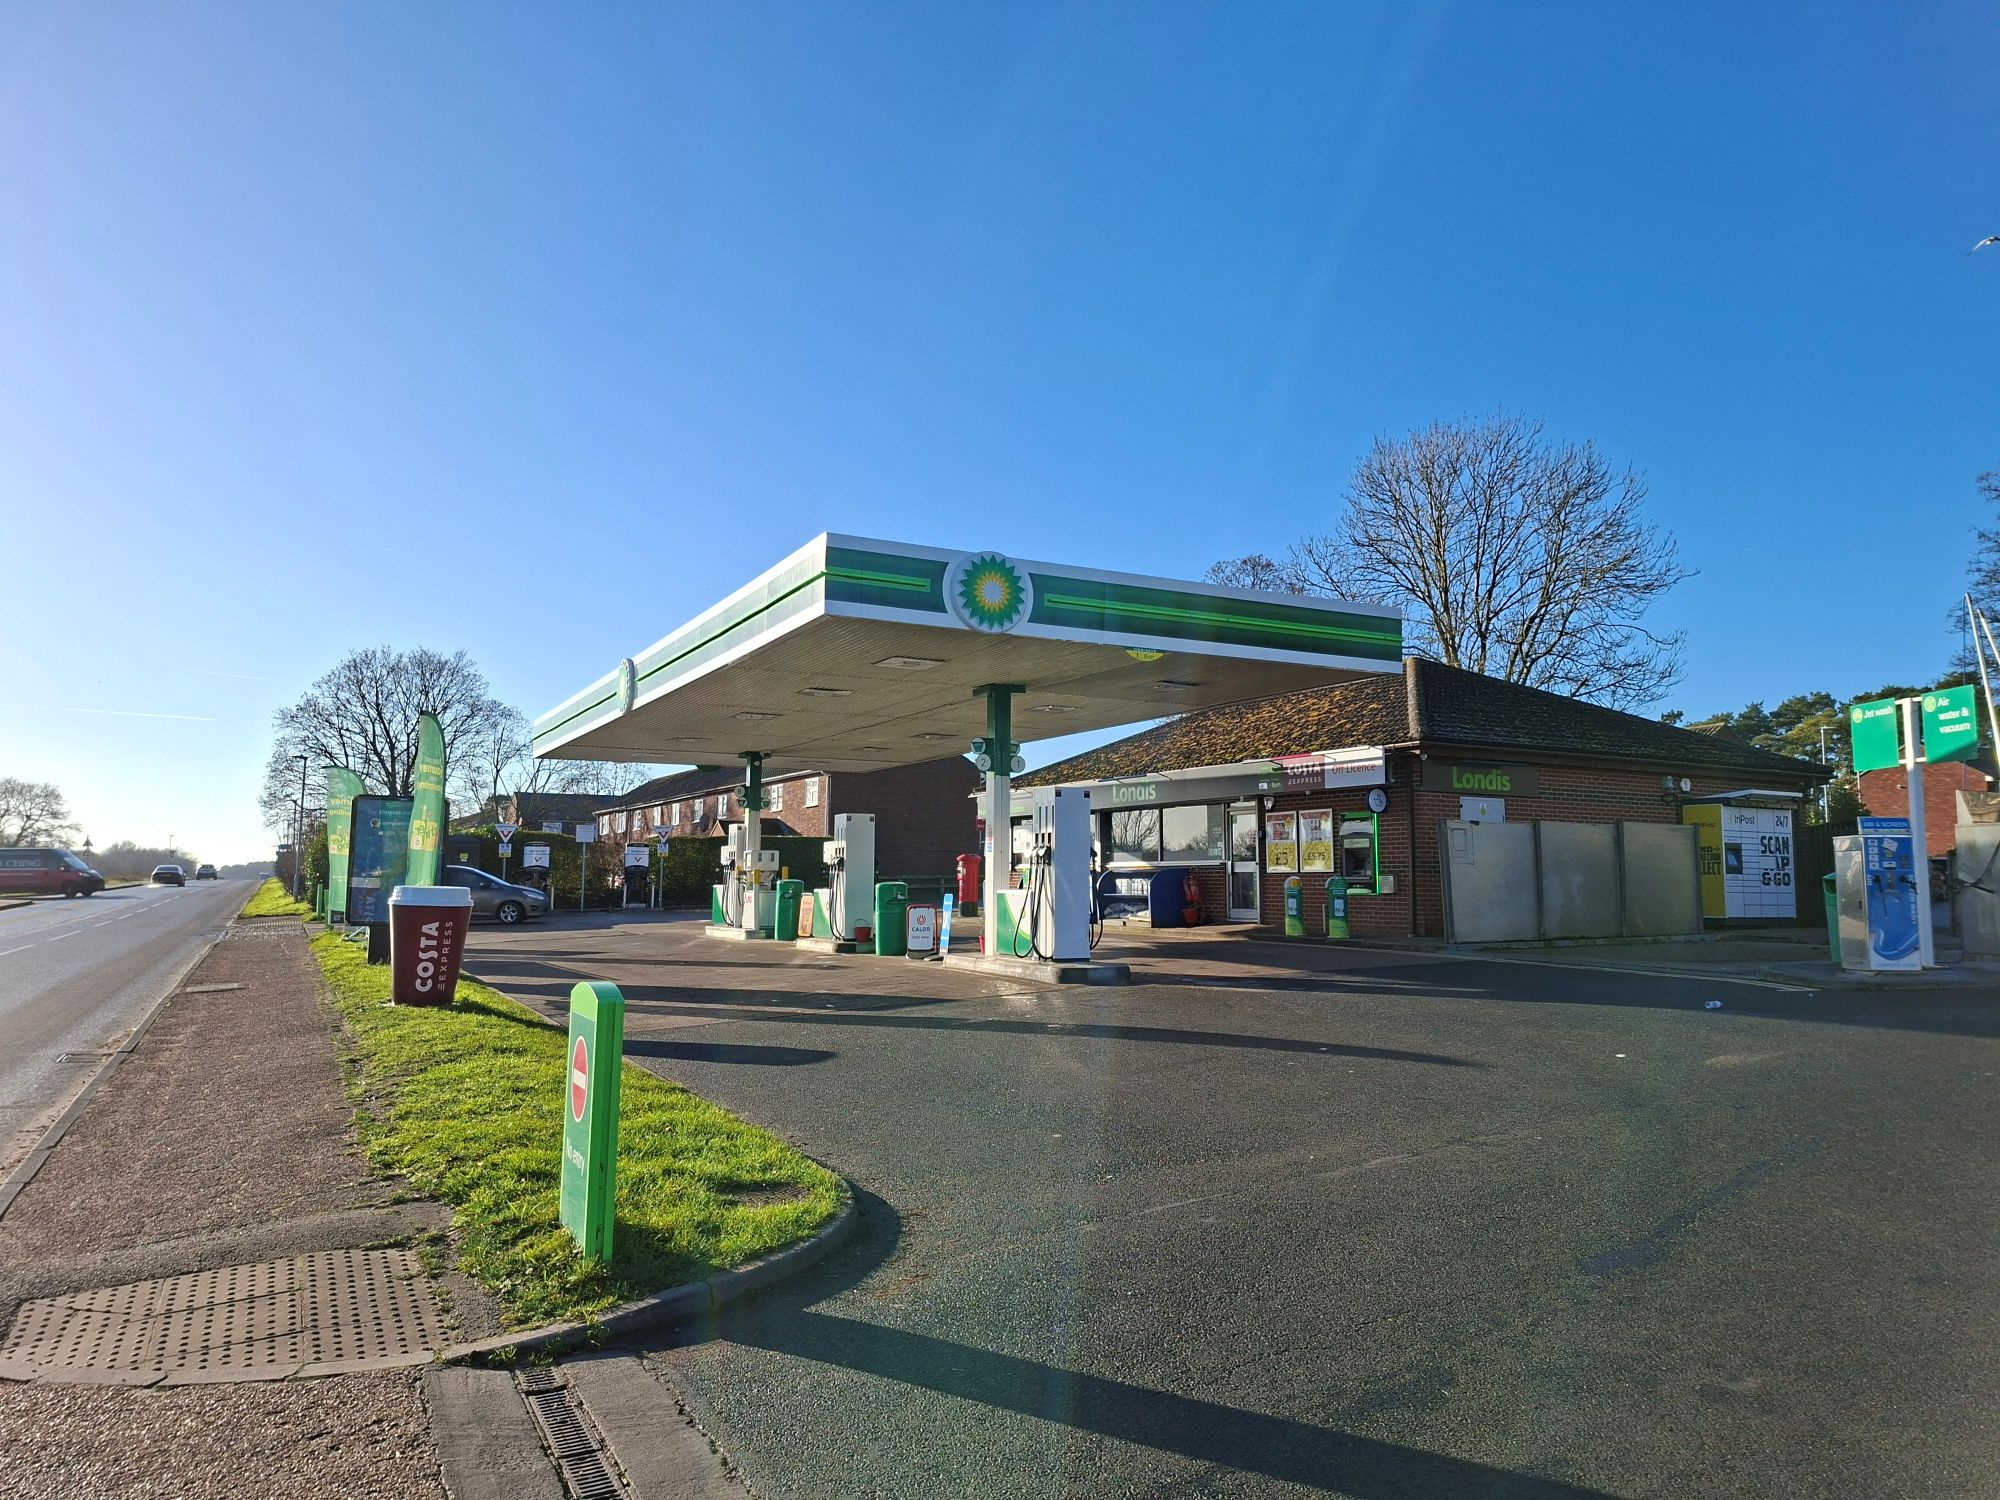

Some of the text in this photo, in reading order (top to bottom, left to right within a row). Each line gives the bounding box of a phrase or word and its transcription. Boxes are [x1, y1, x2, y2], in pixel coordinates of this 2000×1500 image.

[1938, 698, 1949, 707] Air
[1864, 706, 1893, 719] Jet wash
[1938, 707, 1969, 720] water &
[1939, 722, 1971, 733] vacuum
[1288, 762, 1321, 776] COSTA
[1332, 762, 1377, 775] Off Licence
[1293, 776, 1322, 785] EXPRESS
[1452, 766, 1511, 791] Londis
[1735, 815, 1755, 825] InPost
[1775, 816, 1789, 828] 24/7
[1761, 836, 1790, 855] SCAN
[1275, 851, 1289, 866] £3
[1307, 851, 1327, 861] £5.75
[1762, 872, 1791, 886] & GO
[415, 921, 440, 992] COSTA
[439, 921, 454, 981] EXPRESS
[566, 1136, 585, 1177] No entry
